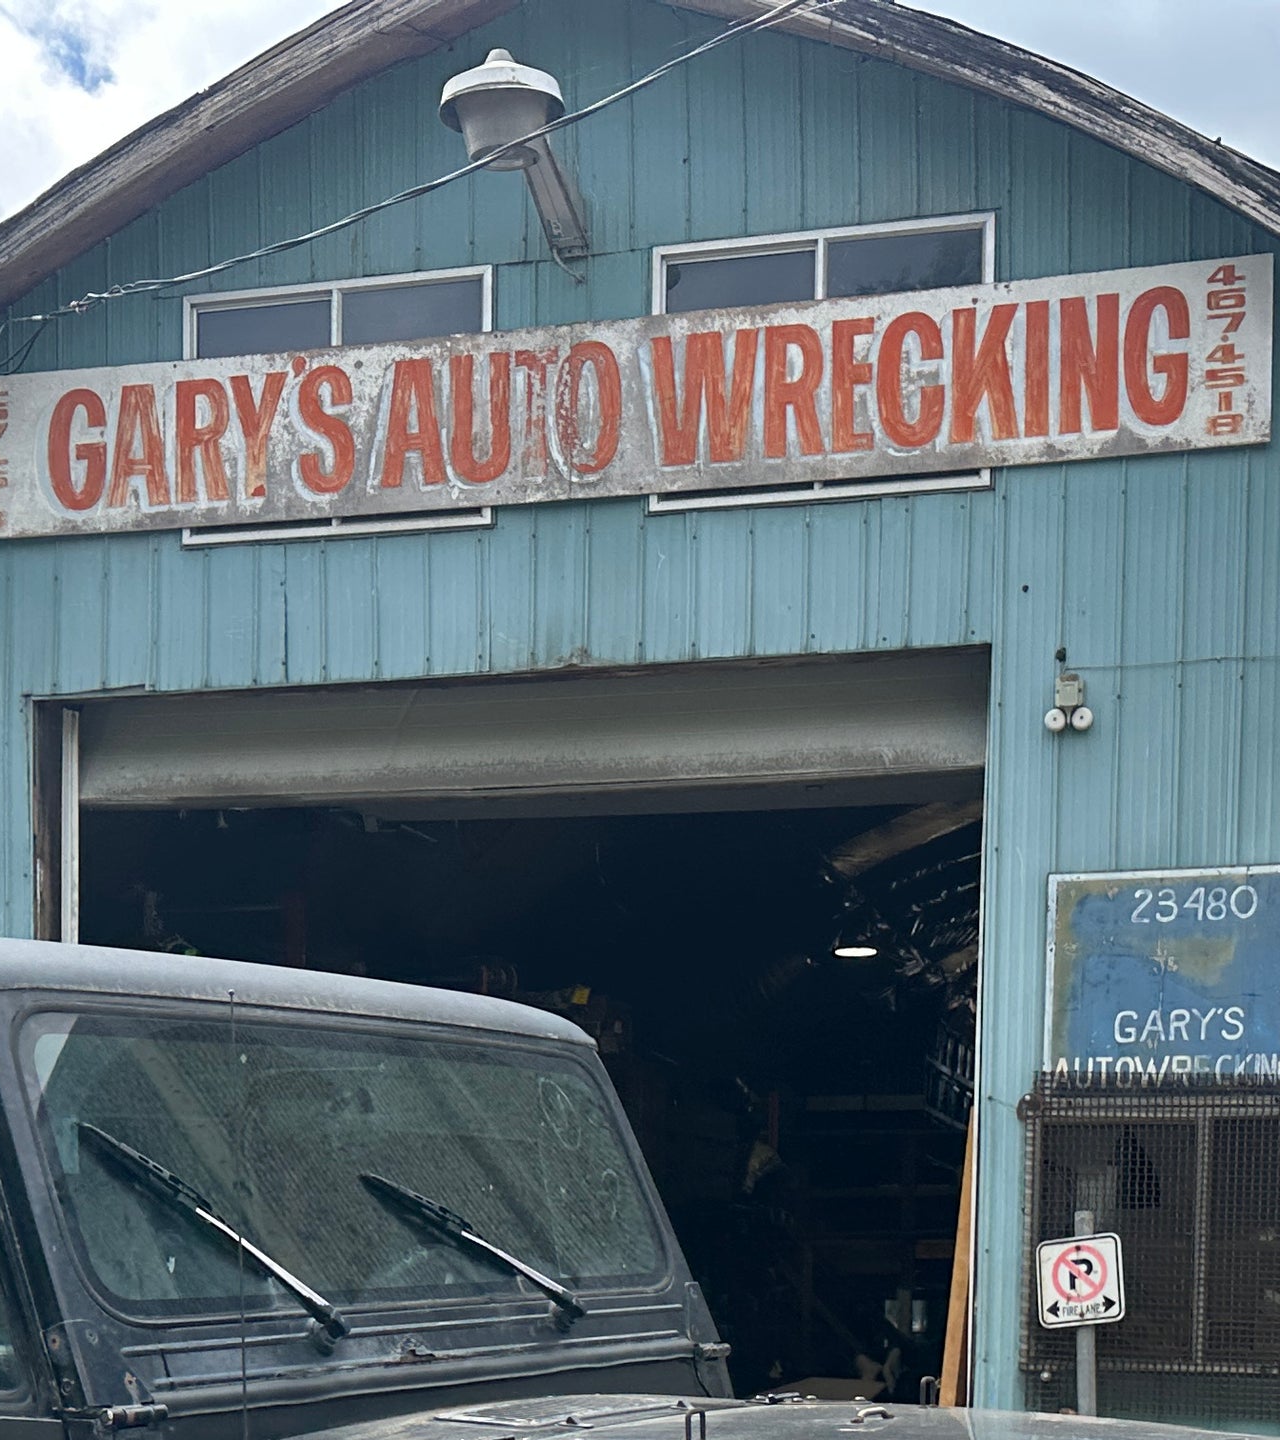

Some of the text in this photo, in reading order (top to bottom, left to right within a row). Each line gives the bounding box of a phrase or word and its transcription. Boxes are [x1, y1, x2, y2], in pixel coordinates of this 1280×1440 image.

[46, 285, 1191, 512] GARY'S AUTO WRECKING
[1130, 885, 1259, 924] 23480
[1113, 1006, 1246, 1044] GARY'S
